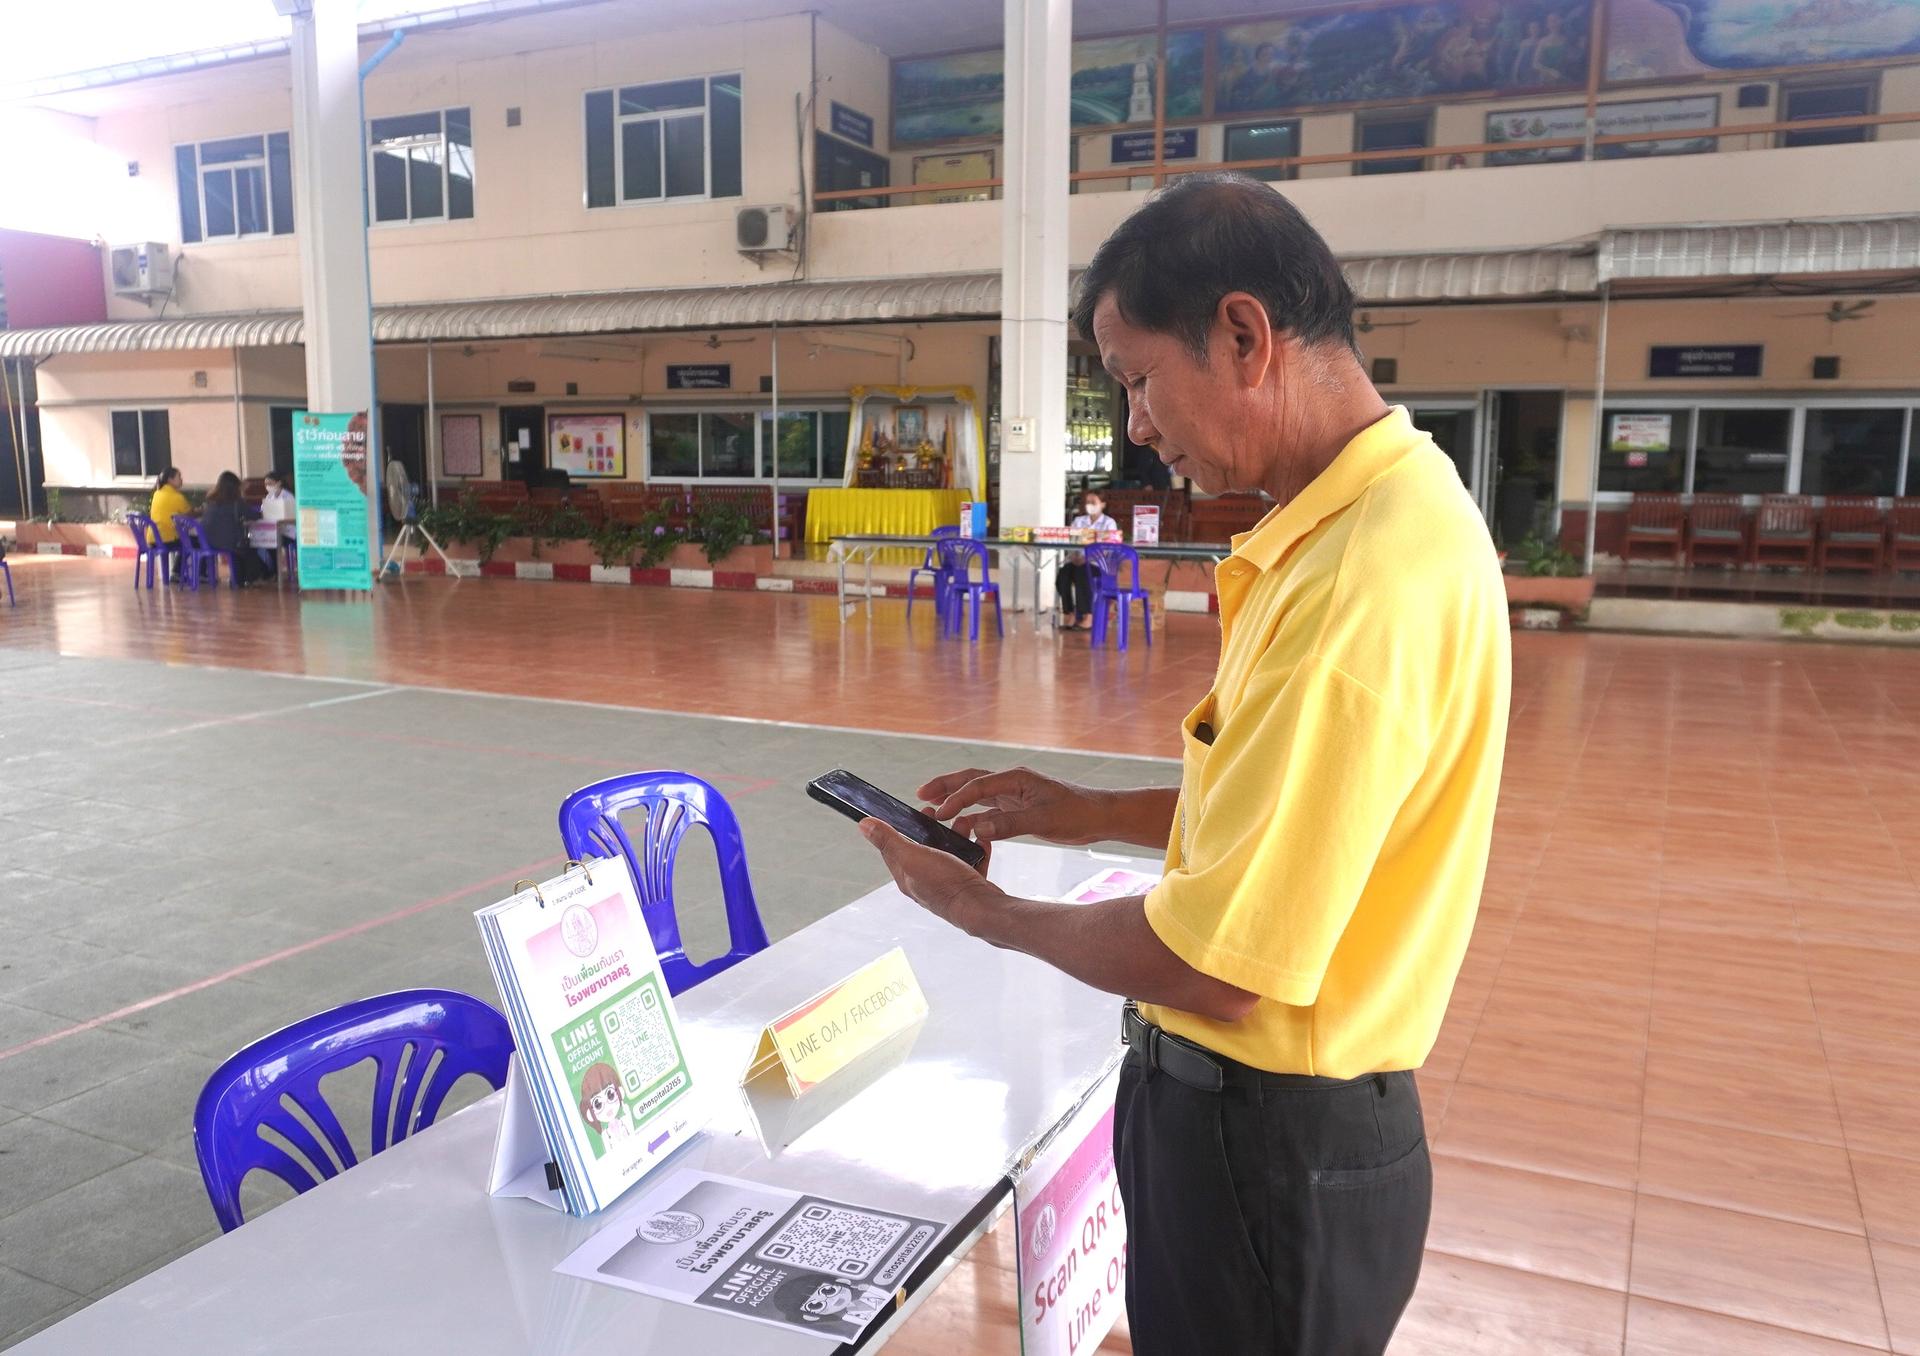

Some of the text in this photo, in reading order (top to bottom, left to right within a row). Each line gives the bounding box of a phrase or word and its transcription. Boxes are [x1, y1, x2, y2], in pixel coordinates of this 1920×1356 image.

[561, 949, 625, 991] เป็นเพื่อนกับเรา
[565, 964, 631, 1007] โรงพยาบาลครู
[561, 1019, 598, 1052] LINE
[632, 1031, 650, 1048] LINE
[790, 1032, 821, 1064] LINE
[821, 1020, 842, 1043] OA
[850, 976, 910, 1024] FACEBOOK
[567, 1037, 602, 1062] OFFICIAL
[571, 1046, 605, 1074] ACCOUNT
[639, 1076, 682, 1114] @hospital22155
[675, 1207, 752, 1270] เป็นเพื่อนกับเรา
[690, 1210, 774, 1274] โรงพยาบาลครู
[822, 1230, 847, 1249] LINE
[882, 1230, 928, 1279] @hospital22155
[713, 1262, 762, 1301] LINE
[1035, 1247, 1077, 1325] Scan
[1082, 1200, 1107, 1256] QR
[734, 1268, 776, 1304] OFFICIAL
[749, 1270, 788, 1307] ACCOUNT
[1068, 1288, 1101, 1356] Line
